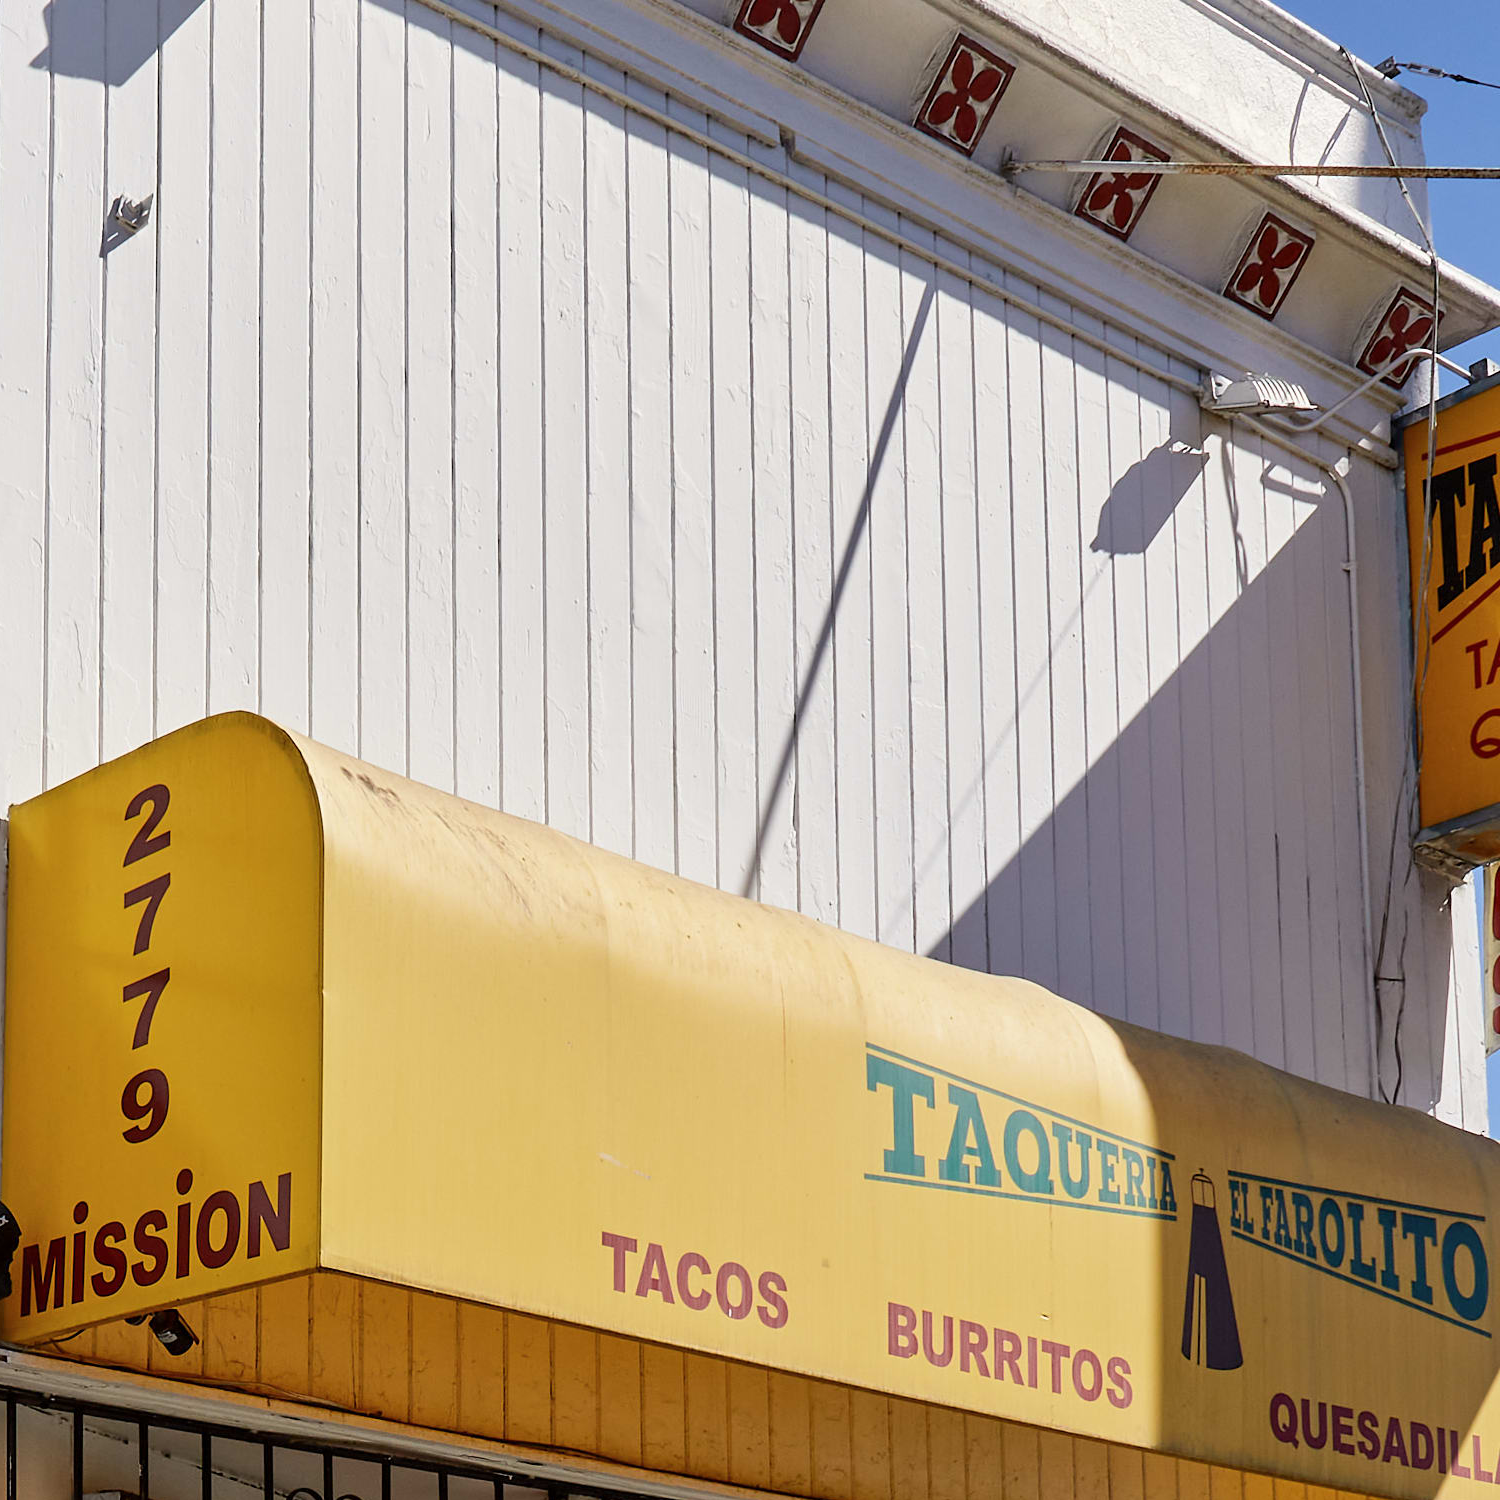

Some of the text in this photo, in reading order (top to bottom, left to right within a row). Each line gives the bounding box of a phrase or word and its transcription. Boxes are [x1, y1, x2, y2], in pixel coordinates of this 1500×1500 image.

[121, 783, 171, 1144] 2779
[600, 1231, 789, 1329] TACOS
[886, 1301, 1133, 1409] BURRITOS
[866, 1053, 1489, 1322] TAQUERIA EL FAROLITO
